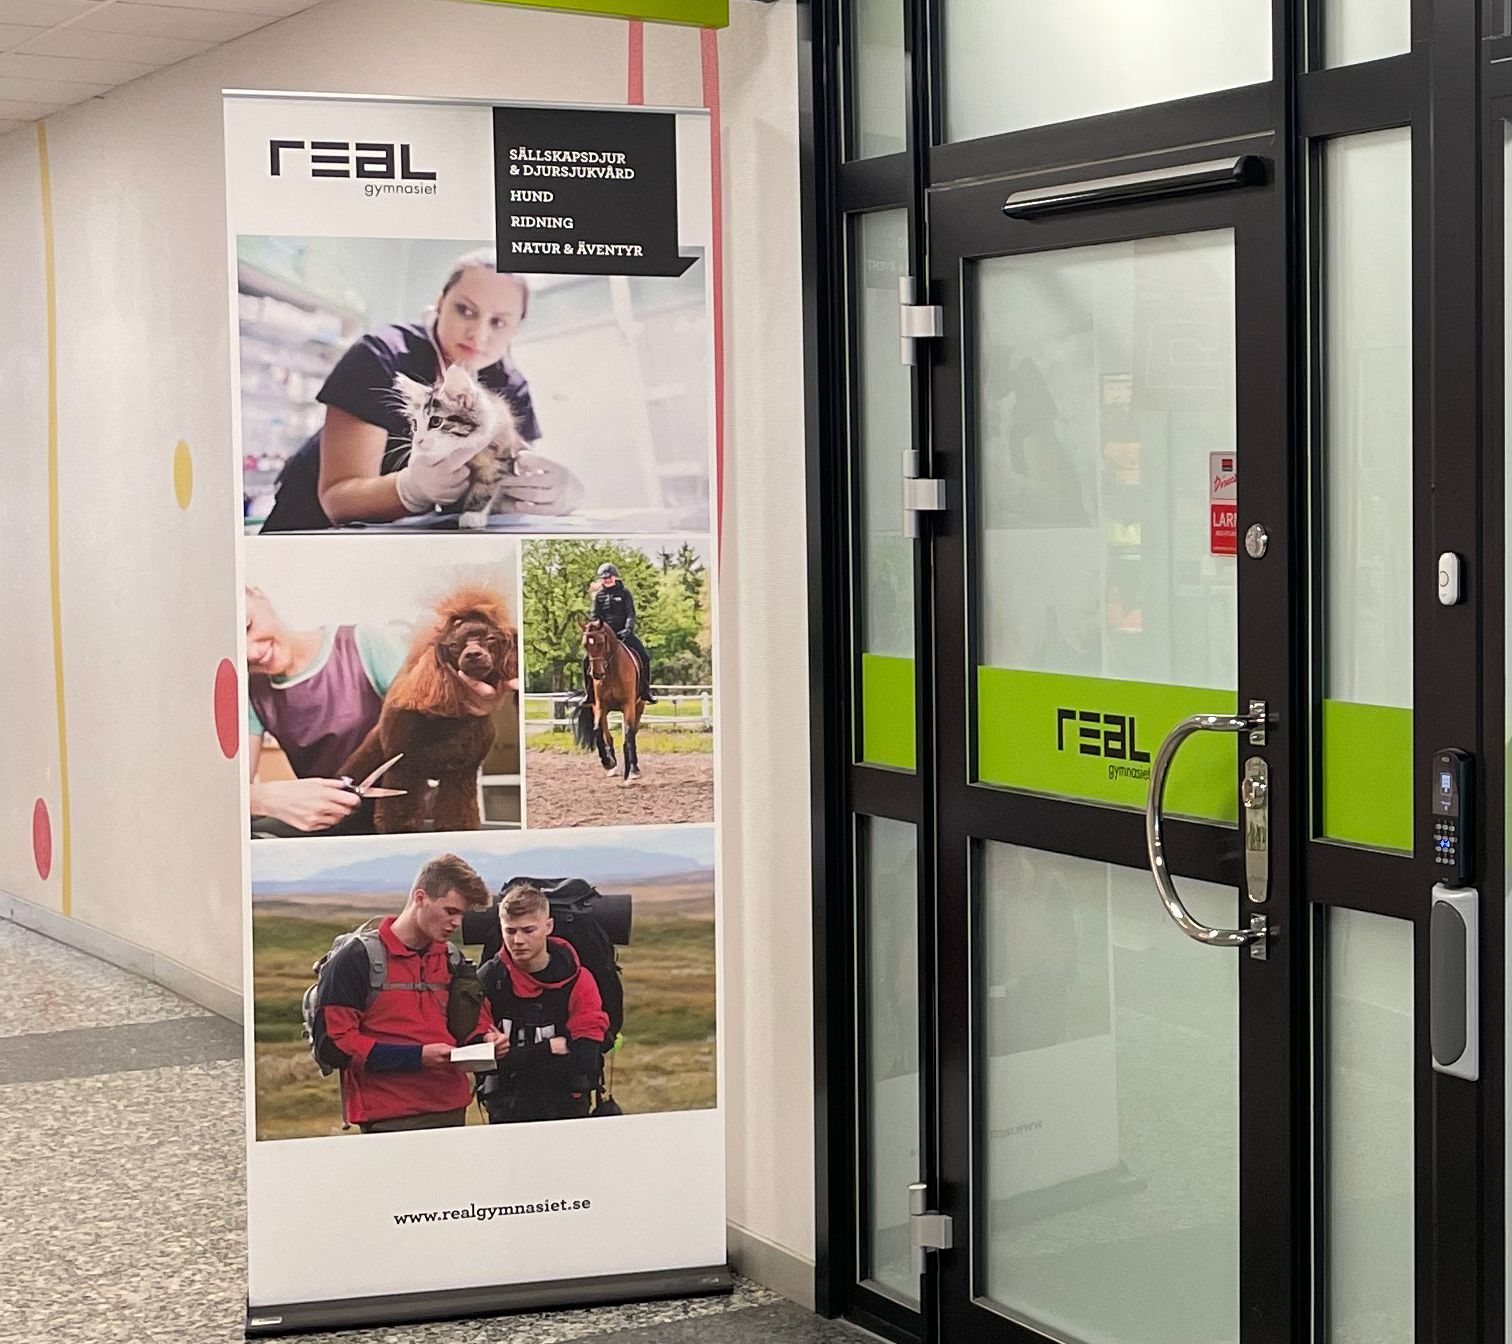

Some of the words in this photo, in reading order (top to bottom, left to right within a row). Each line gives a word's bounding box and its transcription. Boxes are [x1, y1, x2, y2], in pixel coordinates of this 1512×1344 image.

[509, 146, 626, 164] SÄLLSKAPSDJUR
[509, 165, 520, 175] &
[523, 164, 635, 179] DJURSJUKVÅRD
[365, 182, 437, 197] gymnasiet
[510, 190, 554, 202] HUND
[511, 216, 574, 229] RIDNING
[511, 242, 561, 255] NATUR
[564, 244, 574, 255] &
[577, 241, 643, 256] ÄVENTYR
[1213, 512, 1237, 528] LAR
[394, 1199, 591, 1225] www.realgymnasiet.se
